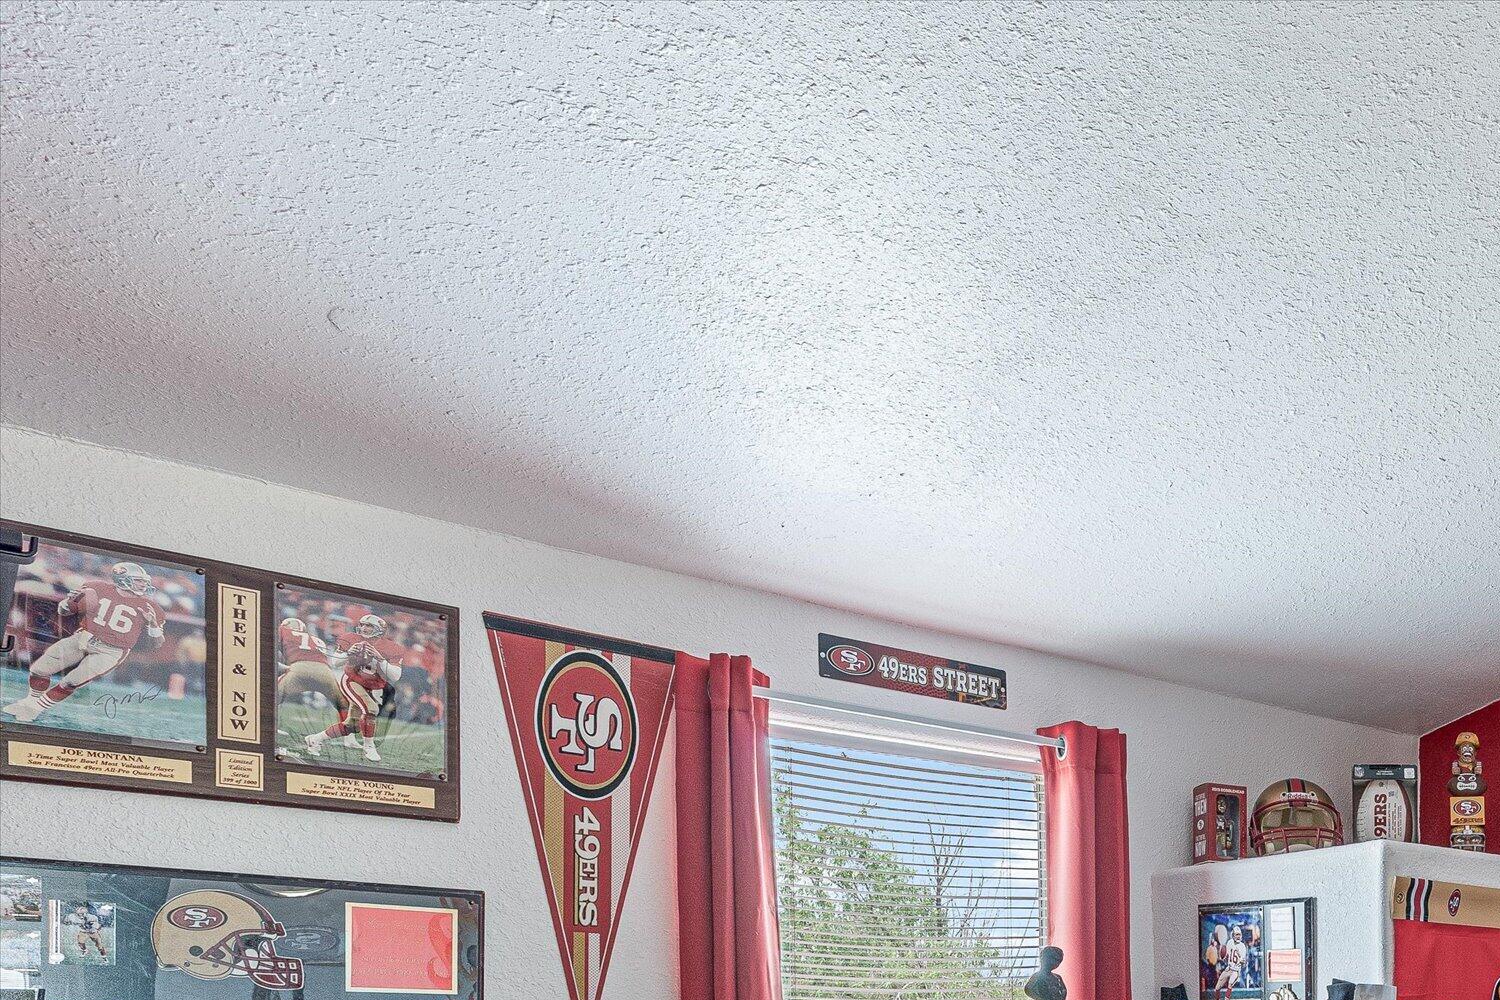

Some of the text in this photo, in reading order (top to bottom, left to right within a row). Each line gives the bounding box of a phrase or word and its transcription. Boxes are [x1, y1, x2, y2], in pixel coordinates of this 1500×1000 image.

[93, 597, 138, 635] 16
[230, 593, 249, 731] THEN & NOW
[840, 650, 866, 671] SF
[878, 655, 1000, 698] 49ERS STREET
[549, 691, 623, 774] SF
[45, 760, 81, 770] Francisco
[84, 764, 102, 772] 49ers
[132, 770, 175, 779] Quarterback
[56, 755, 77, 763] Super
[101, 759, 118, 767] Most
[121, 762, 151, 771] Valuable
[153, 765, 175, 773] Player
[61, 748, 143, 763] JOE MONTANA
[330, 777, 394, 790] STEVE YOUNG
[1374, 793, 1388, 840] 9ERS
[572, 806, 600, 928] 49ERS
[183, 907, 217, 928] SF
